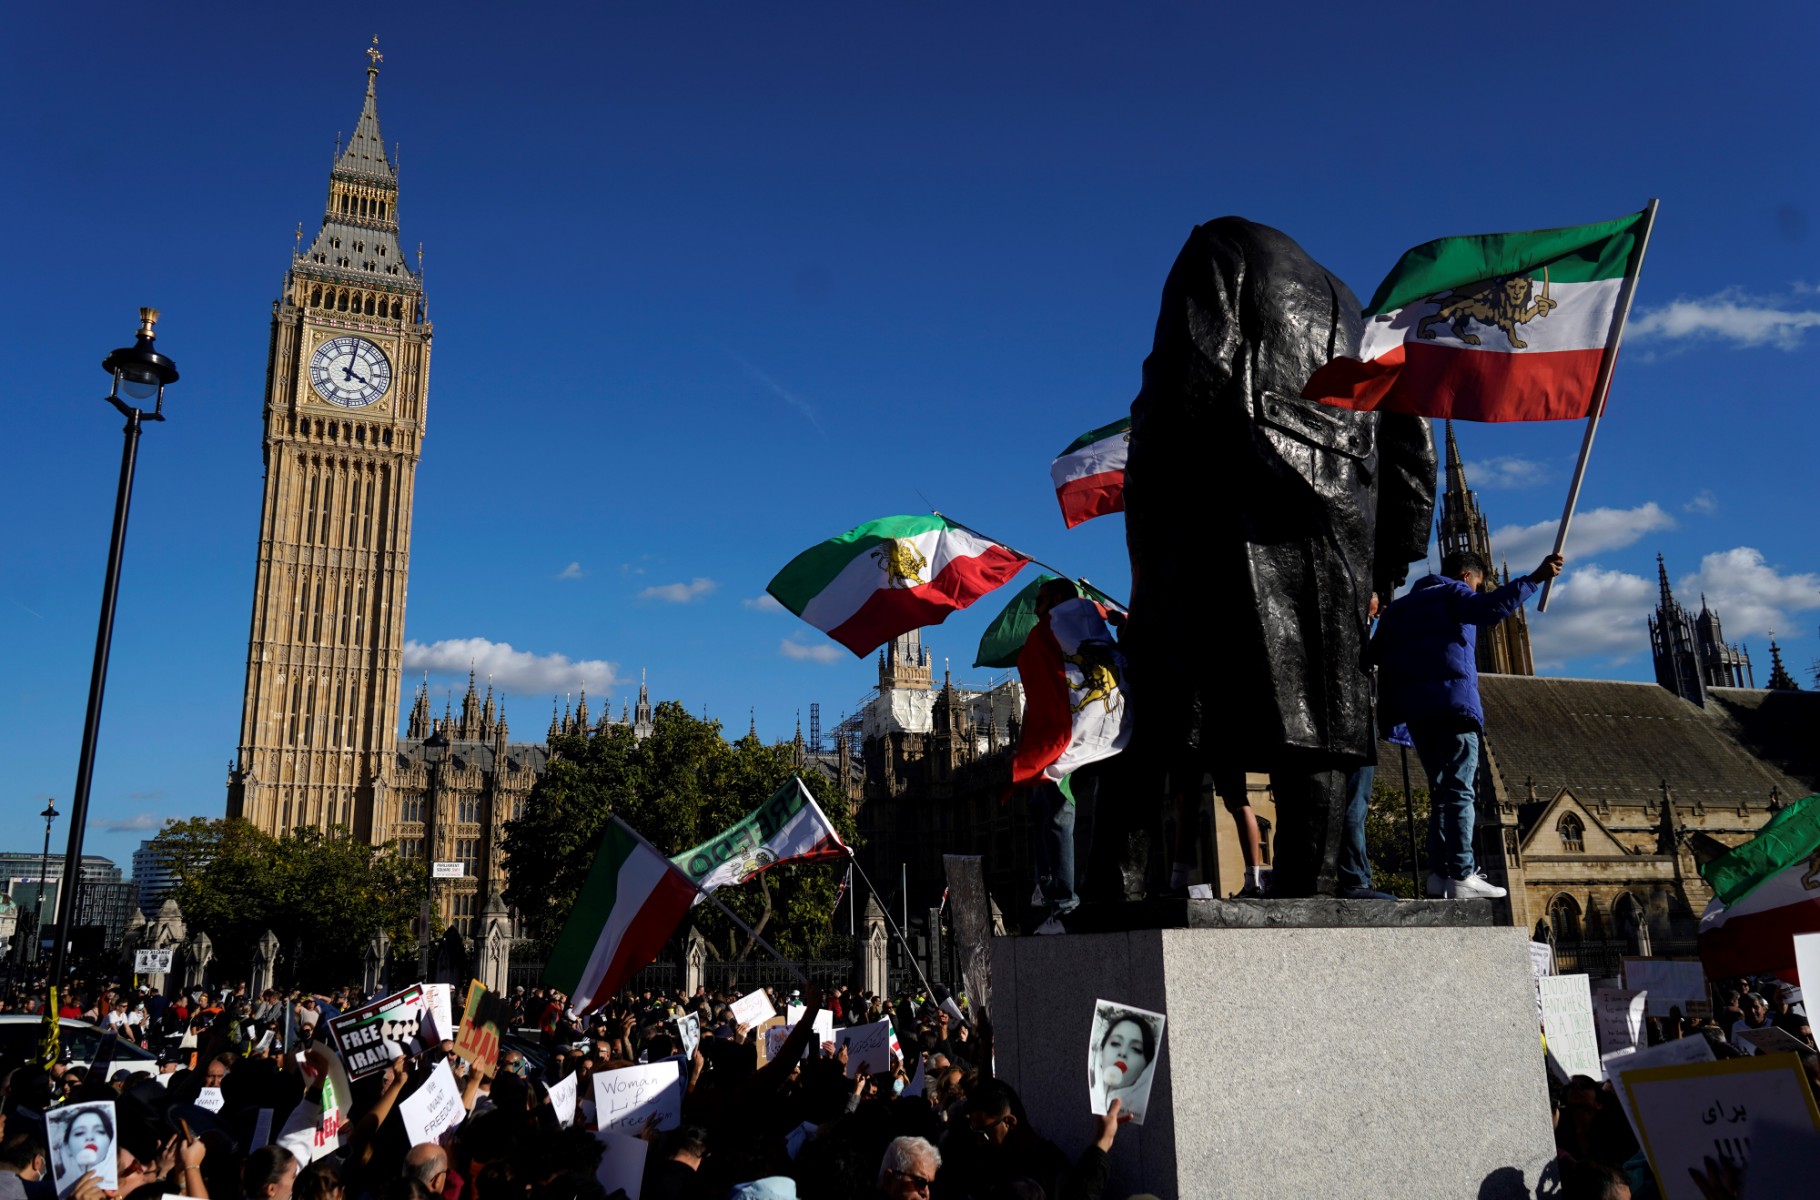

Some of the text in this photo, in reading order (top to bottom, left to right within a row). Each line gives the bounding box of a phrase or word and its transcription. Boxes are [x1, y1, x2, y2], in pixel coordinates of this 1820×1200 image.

[1541, 976, 1588, 995] INJUSTICE
[1545, 992, 1589, 1014] ANYWHERE
[341, 1024, 380, 1050] FREE
[459, 1019, 499, 1065] IRAN
[347, 1044, 389, 1071] IRAN
[601, 1076, 658, 1094] Woman
[427, 1088, 446, 1114] WANT
[610, 1088, 661, 1114] Life
[423, 1097, 456, 1136] FREEDOM
